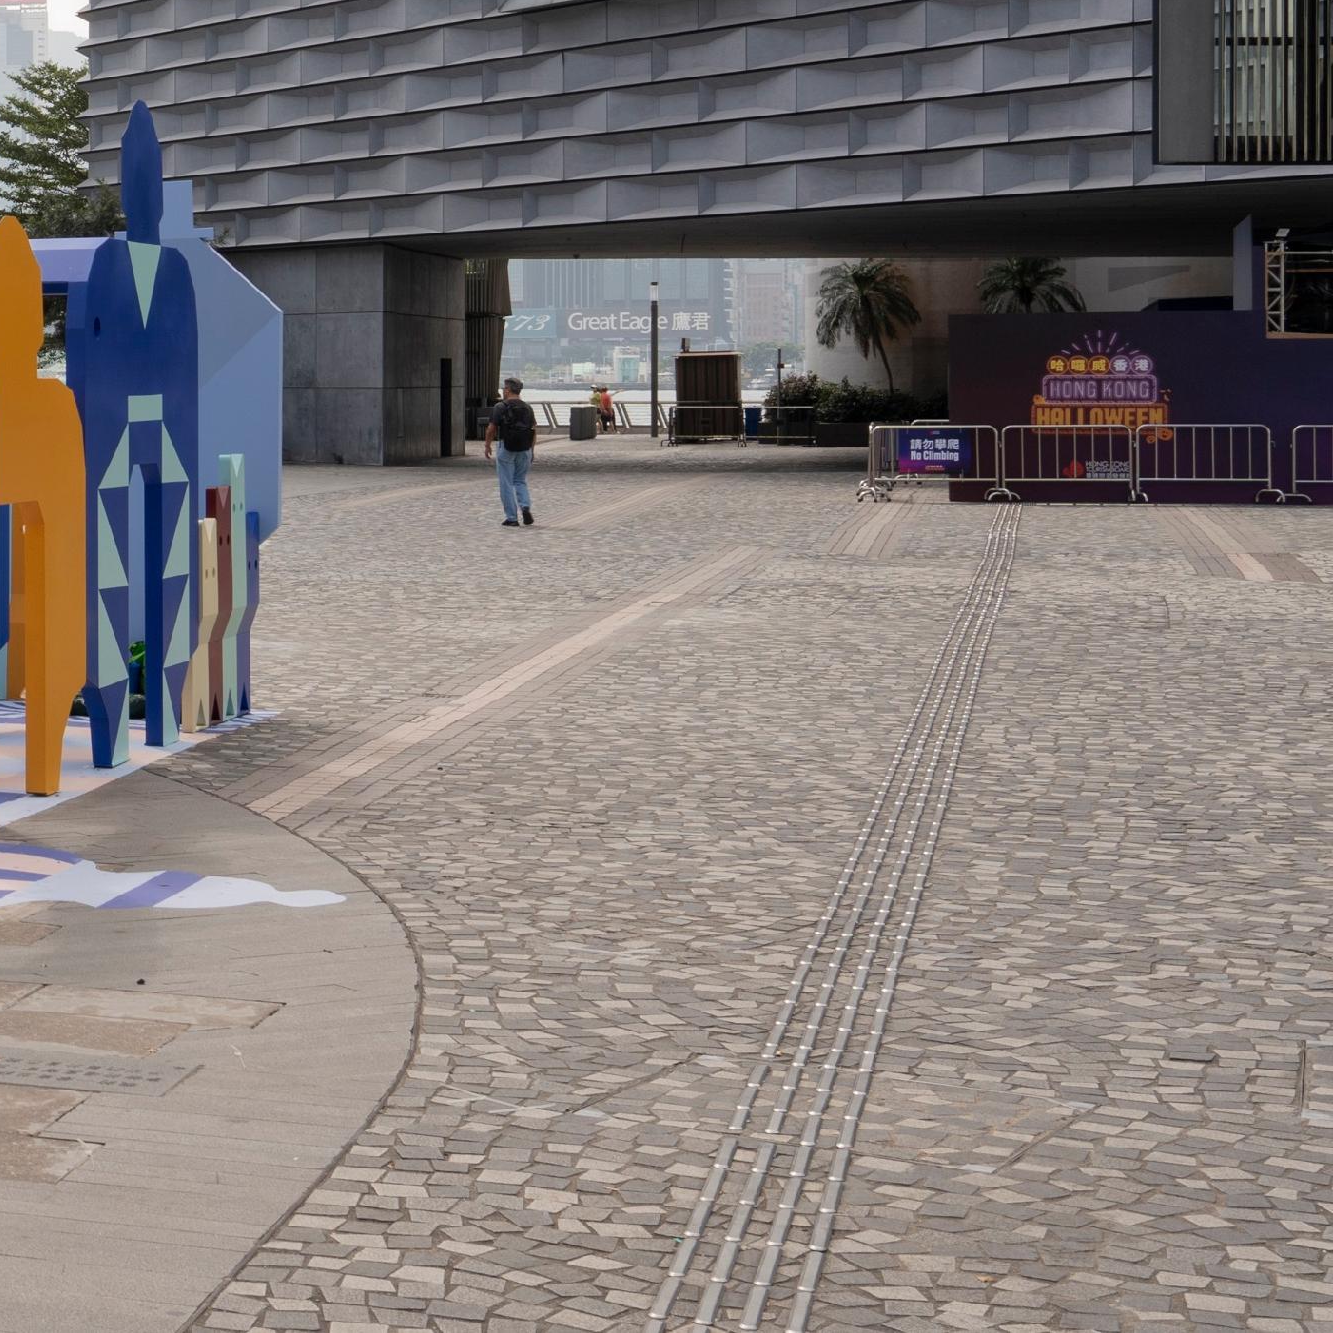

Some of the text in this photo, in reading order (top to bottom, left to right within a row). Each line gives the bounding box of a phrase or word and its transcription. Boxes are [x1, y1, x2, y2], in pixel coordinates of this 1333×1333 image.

[567, 311, 668, 334] Great Eage
[671, 311, 711, 332] 鷹君
[1050, 380, 1150, 399] HONG KONG
[1035, 406, 1164, 426] HALLOWEEN
[909, 438, 960, 450] 請勿攀爬
[910, 450, 960, 462] No Climbing
